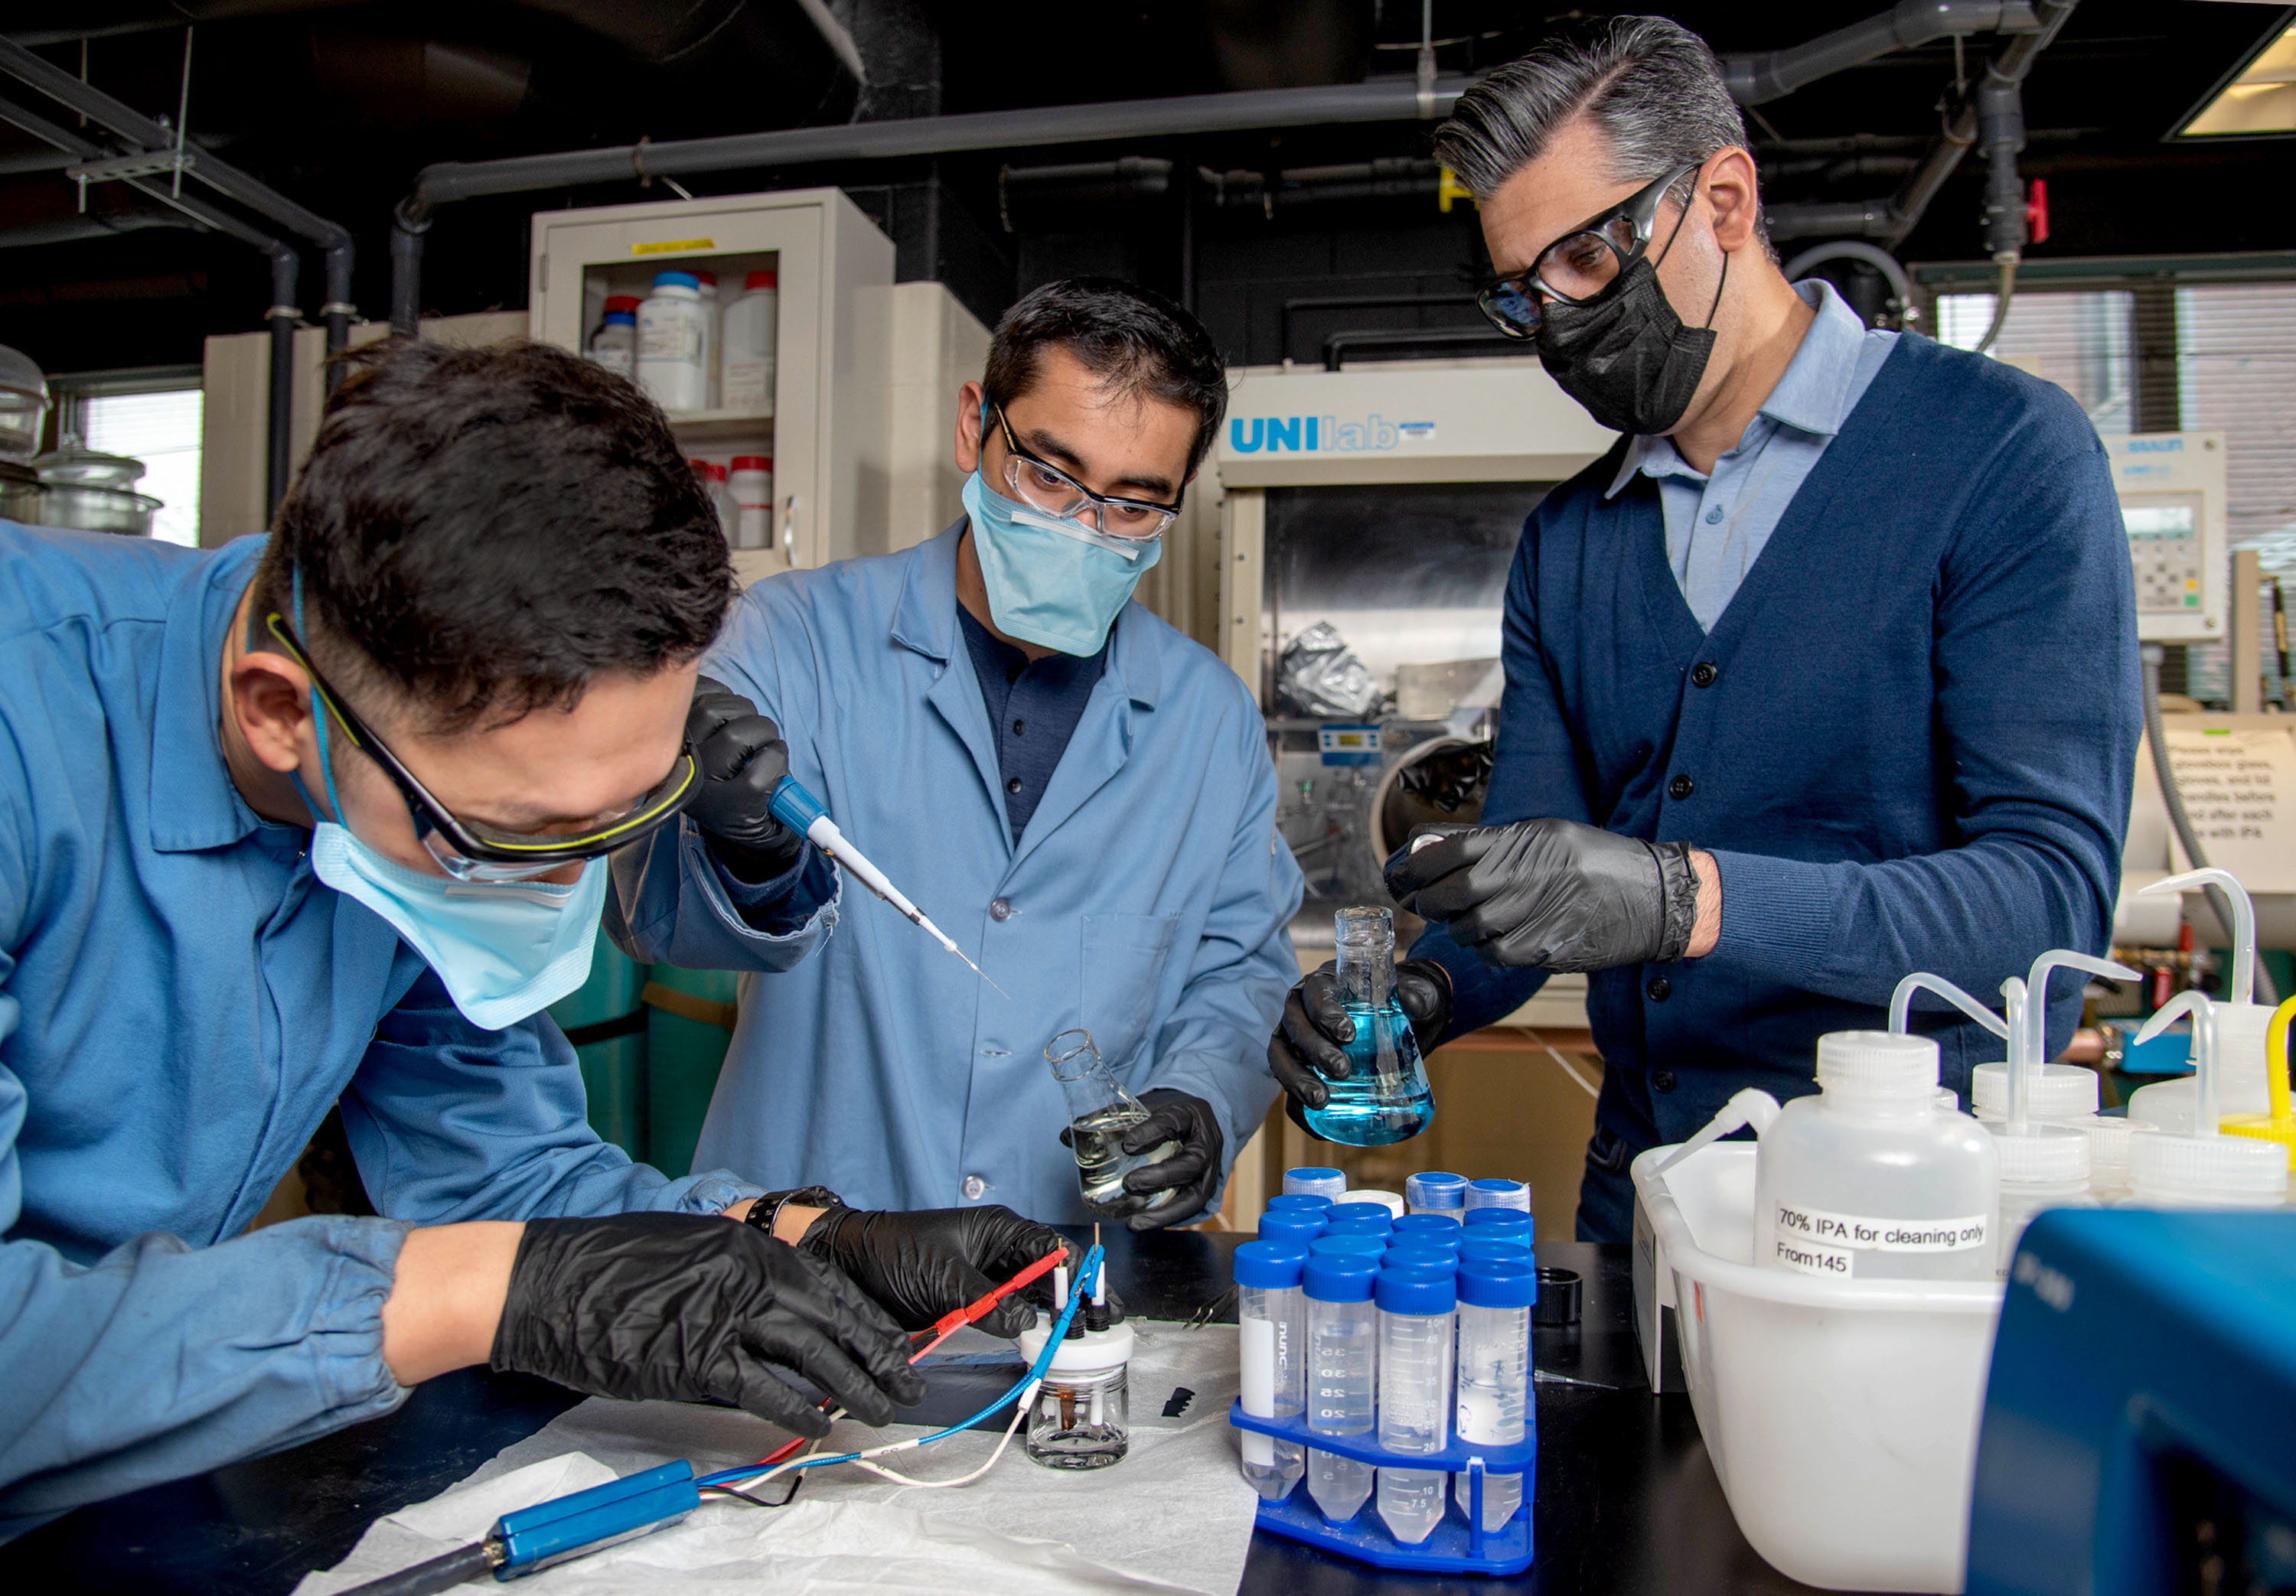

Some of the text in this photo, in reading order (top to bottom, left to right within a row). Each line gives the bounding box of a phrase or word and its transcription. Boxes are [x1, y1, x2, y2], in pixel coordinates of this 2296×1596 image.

[1231, 414, 1399, 453] UNIlab
[1780, 1208, 1984, 1246] 70% IPA for cleaning only
[1279, 1321, 1287, 1370] nunc
[1424, 1442, 1435, 1452] 20
[1424, 1486, 1433, 1495] 10
[1411, 1499, 1427, 1508] 7.5
[1426, 1510, 1432, 1518] 5
